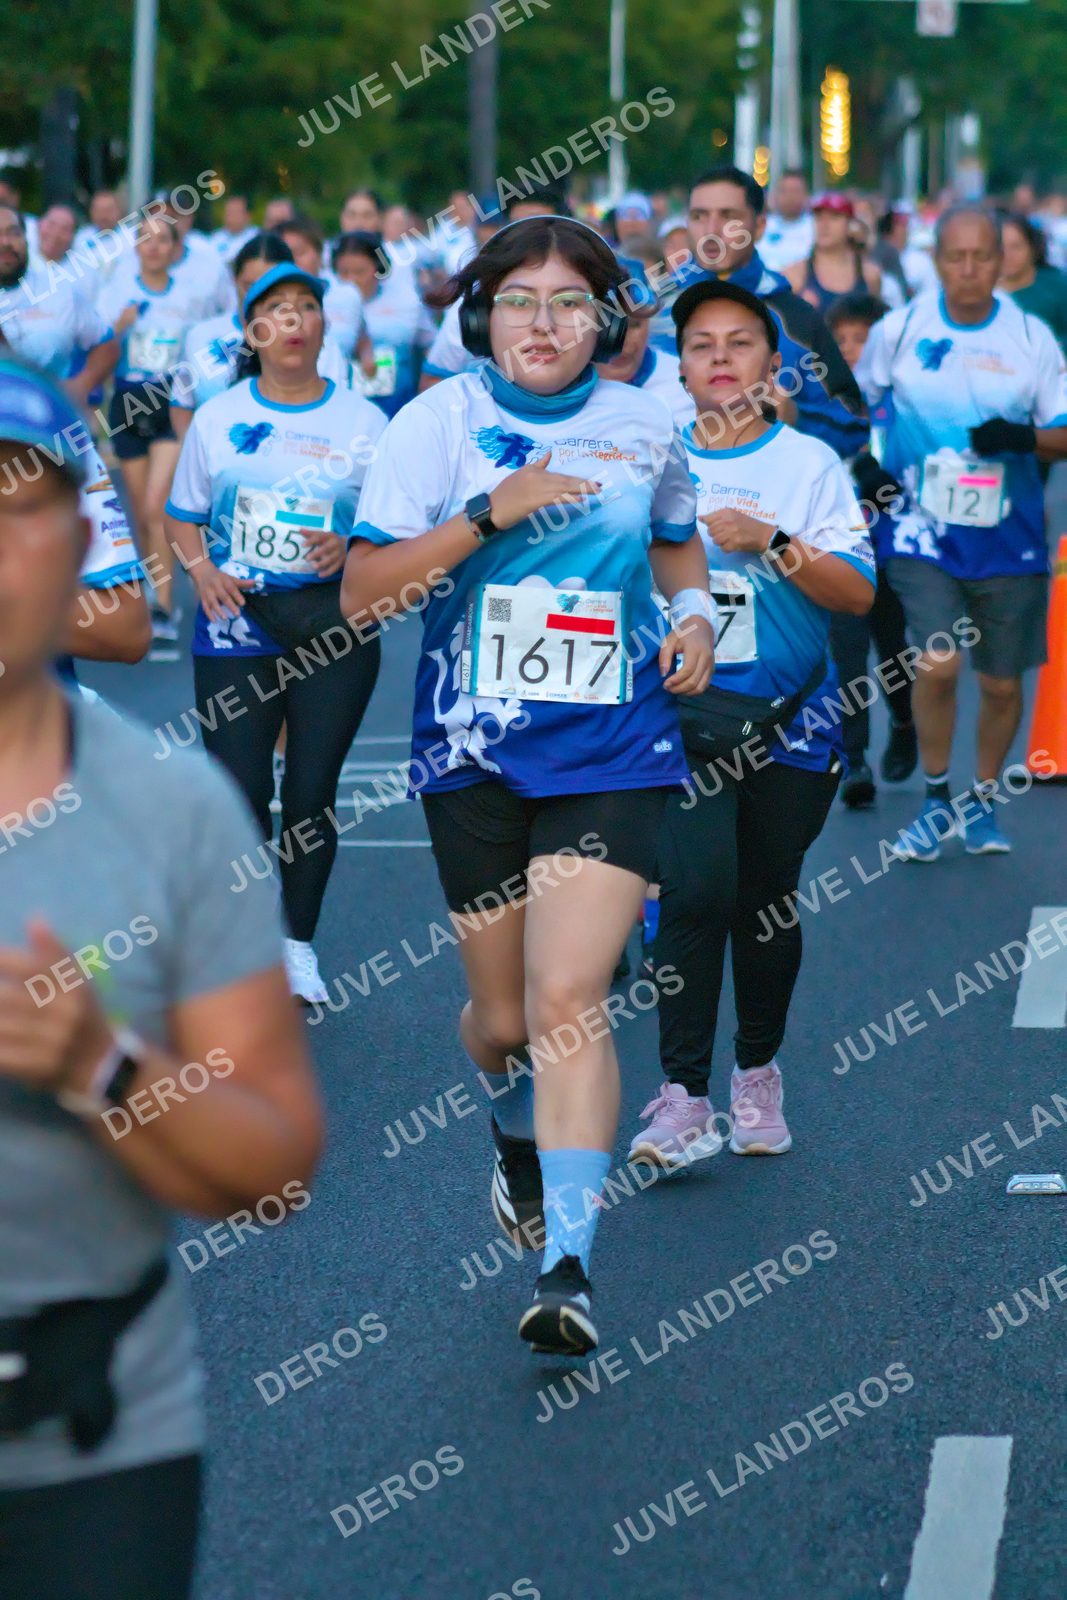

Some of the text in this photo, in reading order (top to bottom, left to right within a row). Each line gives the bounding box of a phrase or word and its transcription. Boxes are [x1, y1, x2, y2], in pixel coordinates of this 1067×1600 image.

[711, 483, 760, 499] Carrera
[736, 497, 758, 508] Vida
[947, 487, 980, 517] 12
[491, 634, 620, 688] 1617
